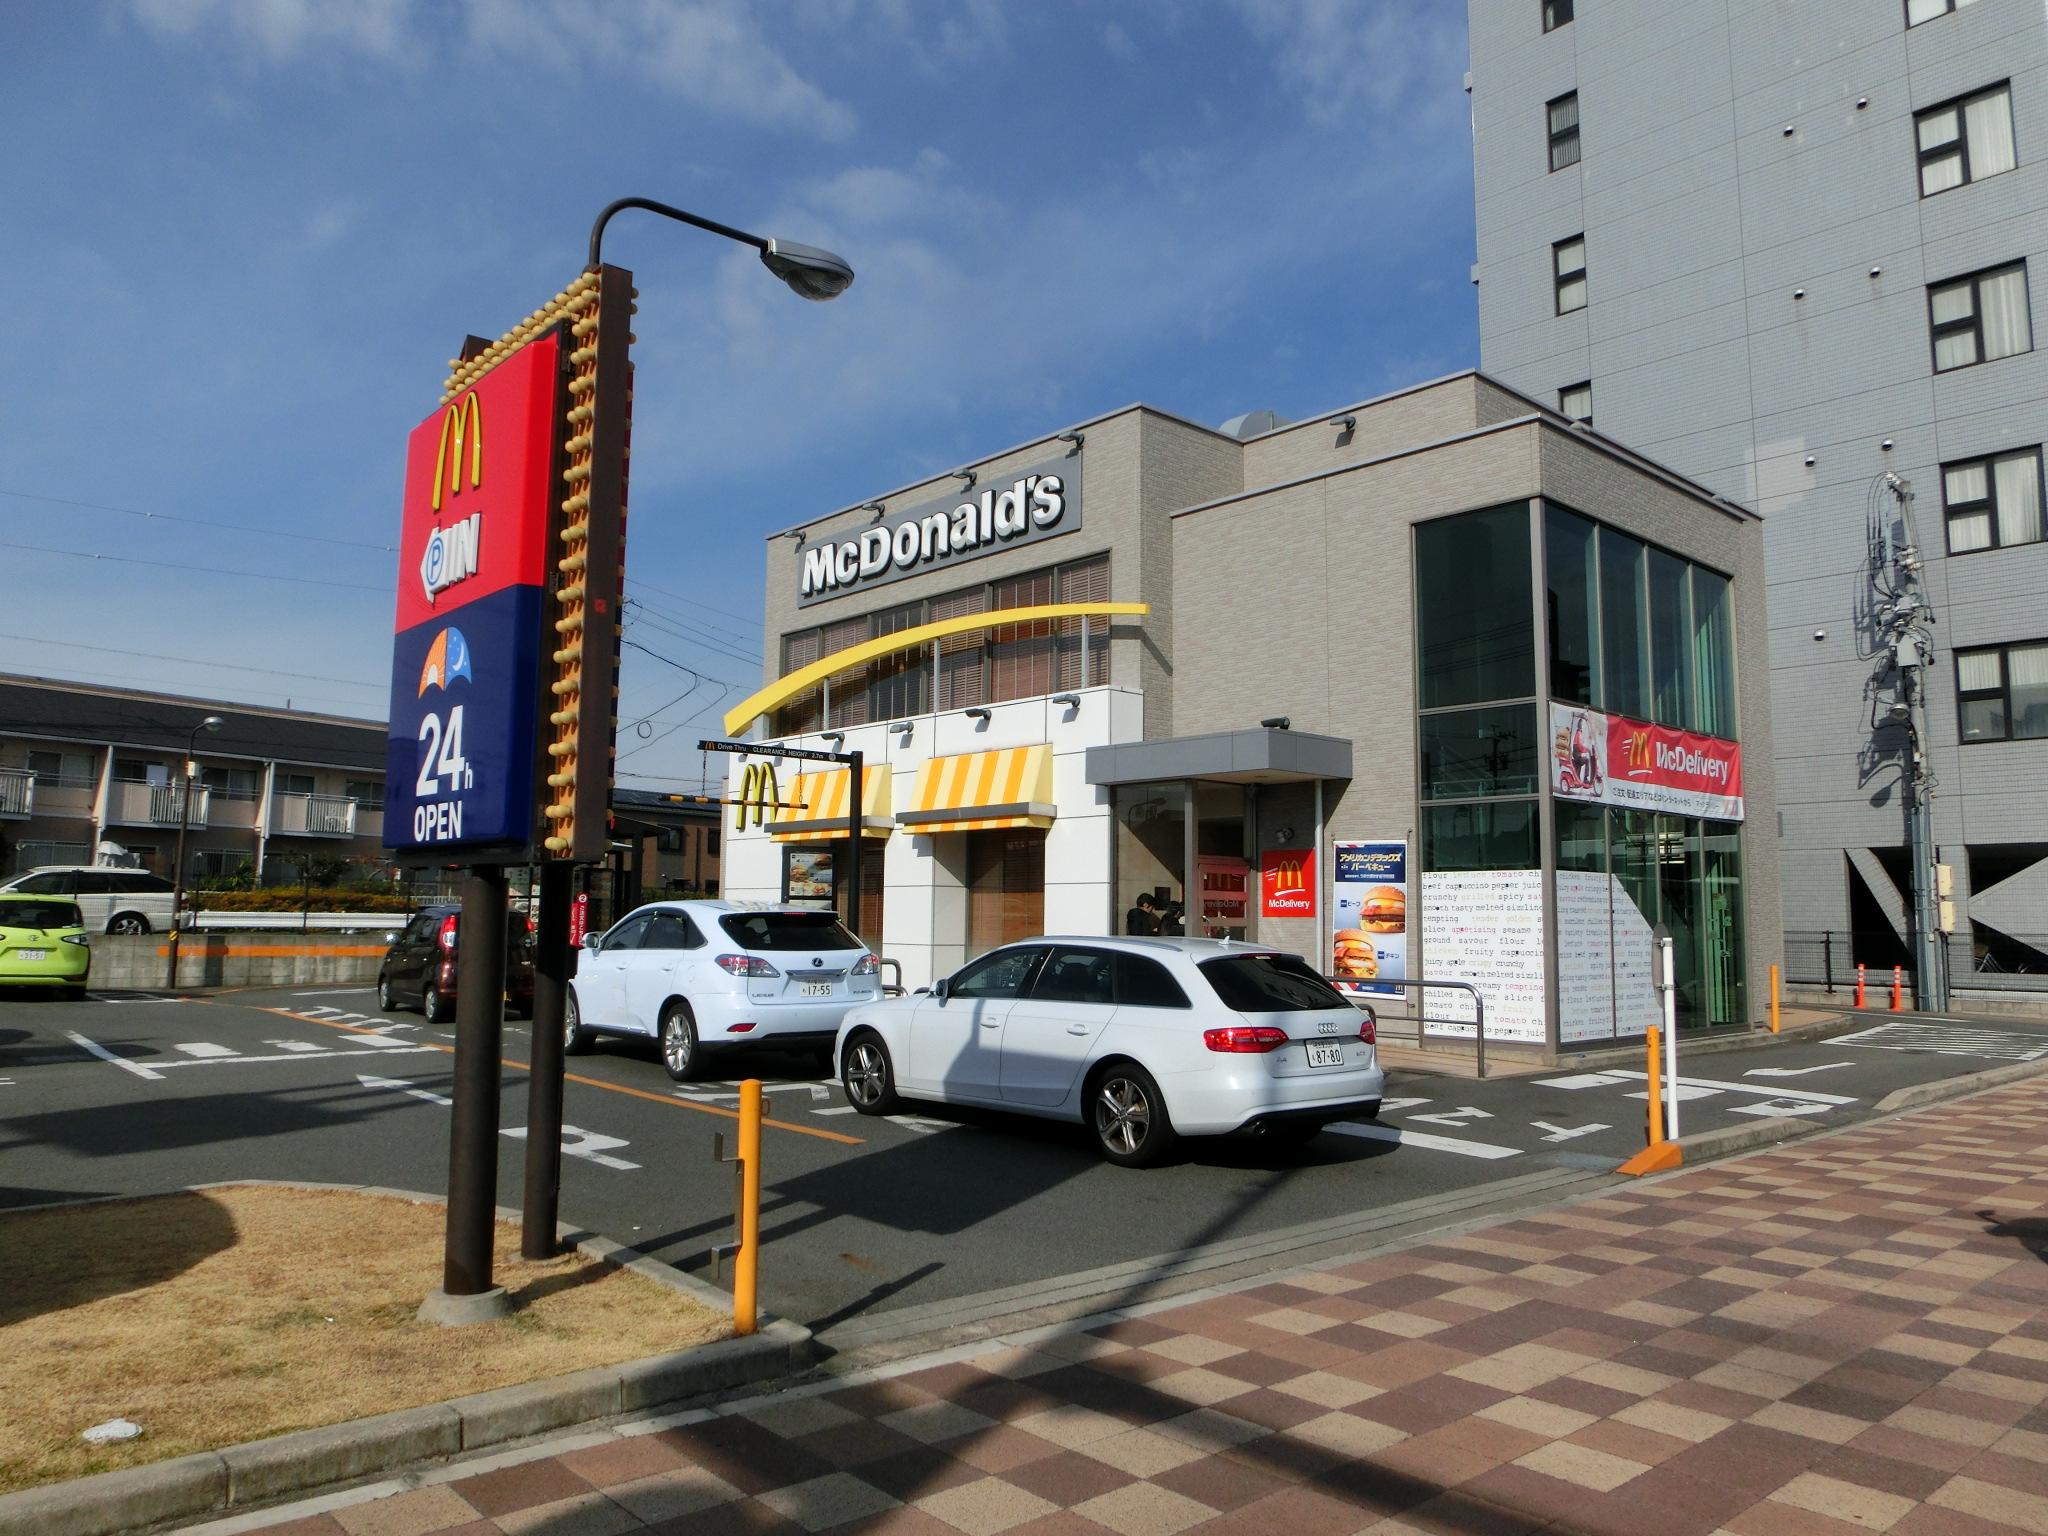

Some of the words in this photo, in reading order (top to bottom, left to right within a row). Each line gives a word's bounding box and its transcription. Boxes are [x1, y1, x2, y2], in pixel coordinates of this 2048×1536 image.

[800, 474, 1066, 597] McDonald's
[718, 742, 732, 751] Drive
[734, 744, 747, 752] Thru
[752, 746, 786, 756] CLEARANCE
[788, 750, 808, 758] HEIGHT
[1656, 742, 1728, 786] McDelivery
[414, 800, 463, 842] OPEN
[1339, 853, 1401, 862] アメリカンデラックス
[1350, 863, 1391, 871] バーベキュー
[1492, 882, 1519, 890] pepper
[1268, 899, 1310, 910] McDelivery
[1464, 948, 1494, 956] fruity
[1447, 958, 1466, 966] apple
[808, 985, 830, 996] 17-55
[1505, 983, 1544, 991] tempting
[1505, 993, 1533, 1001] slice
[1494, 1016, 1526, 1024] tomato
[1448, 1025, 1491, 1033] cappuccno
[1494, 1028, 1522, 1036] pepper
[1316, 1050, 1340, 1063] 87-80
